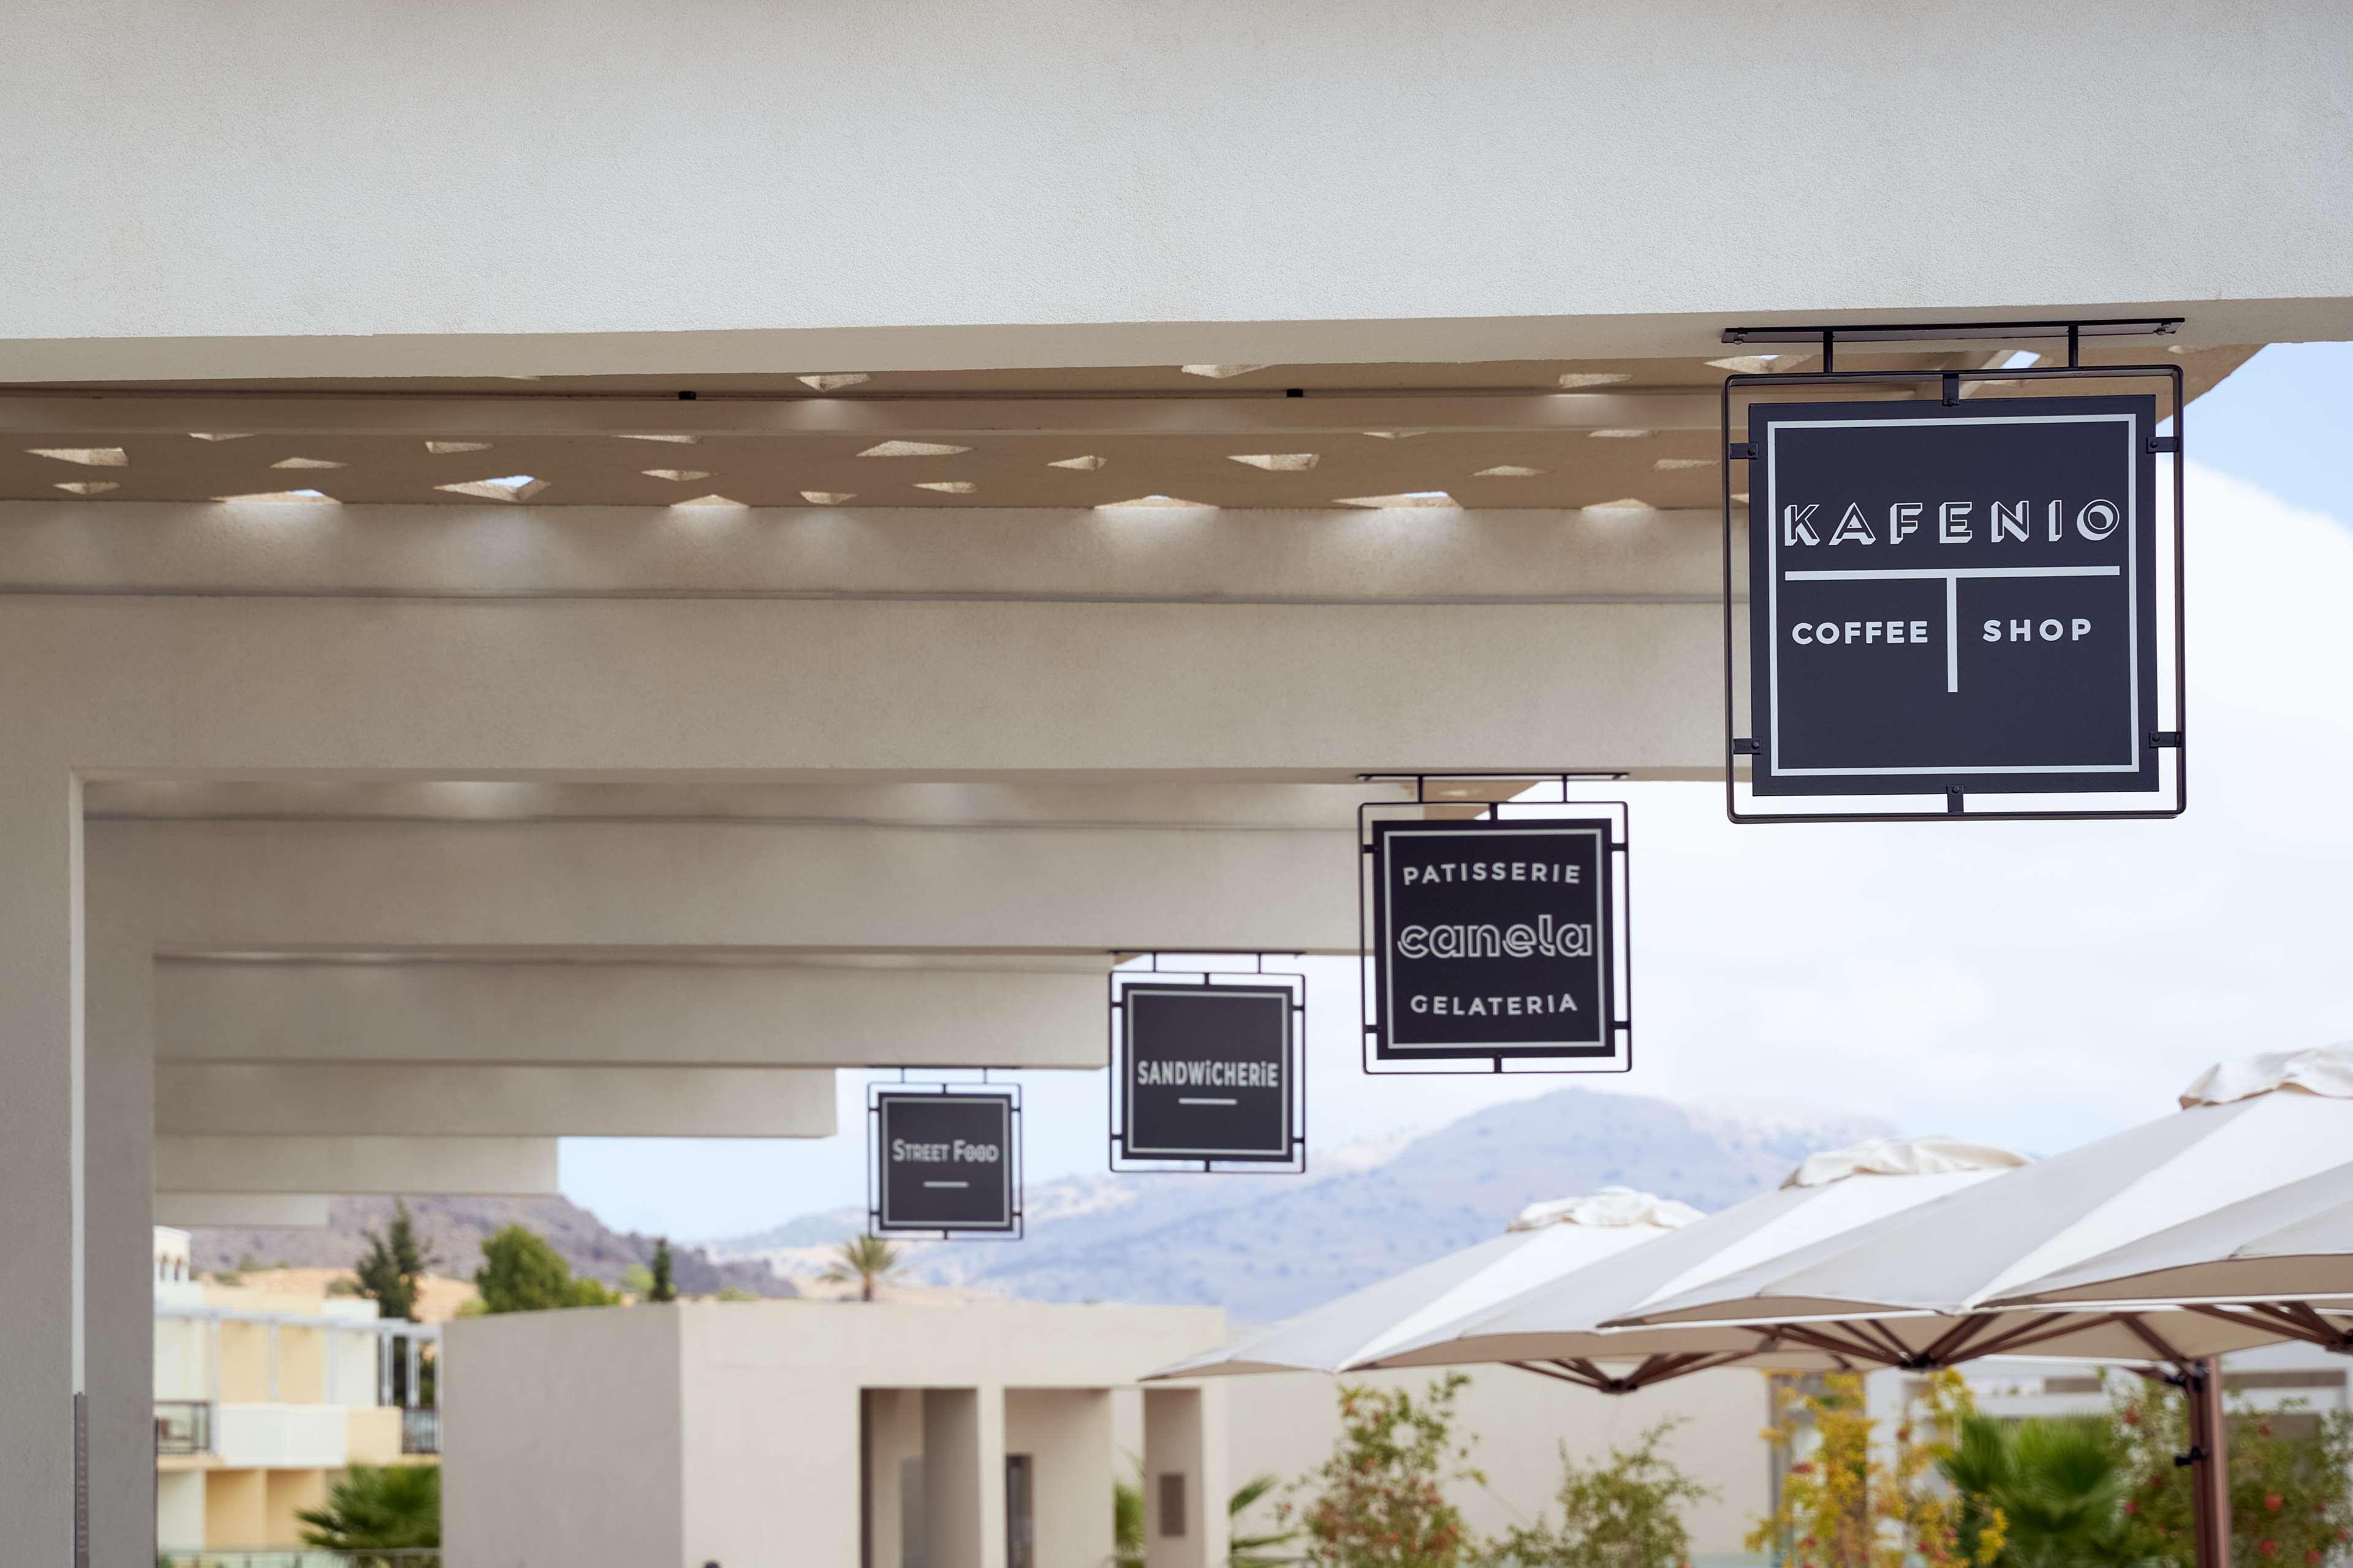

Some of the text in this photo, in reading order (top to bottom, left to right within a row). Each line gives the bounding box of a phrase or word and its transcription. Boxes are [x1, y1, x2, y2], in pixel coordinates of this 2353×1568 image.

[1784, 499, 2120, 547] KAFENIO
[1792, 618, 2091, 645] COFFEE SHOP
[1403, 862, 1581, 886] PATISSERIE
[1396, 914, 1593, 960] canela
[1410, 993, 1578, 1017] GELATERIA
